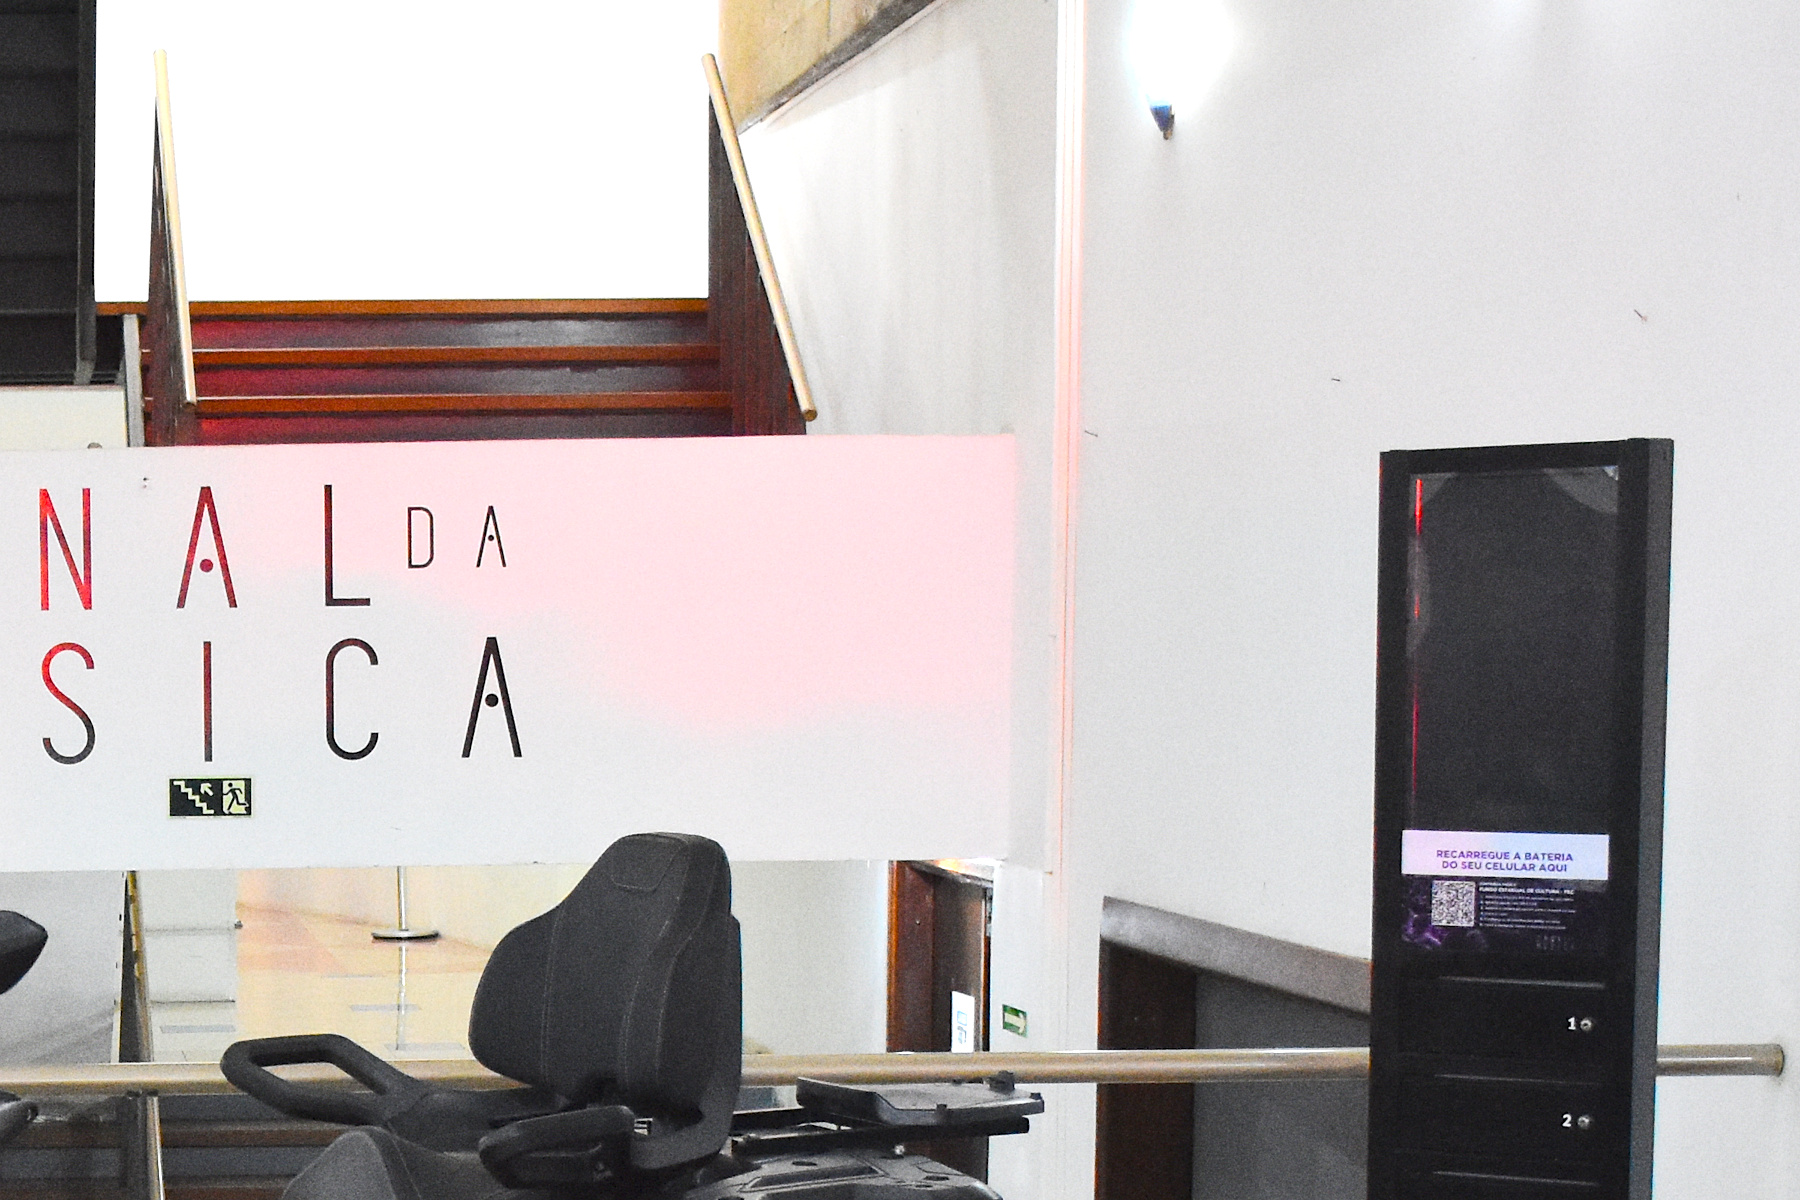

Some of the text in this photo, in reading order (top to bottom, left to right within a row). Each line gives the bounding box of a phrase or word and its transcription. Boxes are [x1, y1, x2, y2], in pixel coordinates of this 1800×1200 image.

[407, 505, 507, 568] DA
[1436, 850, 1573, 862] RECARREGUE A BATERIA
[1442, 860, 1567, 872] DO SEU CELULAR AQUI
[1568, 1017, 1576, 1030] 1
[1562, 1114, 1572, 1127] 2
